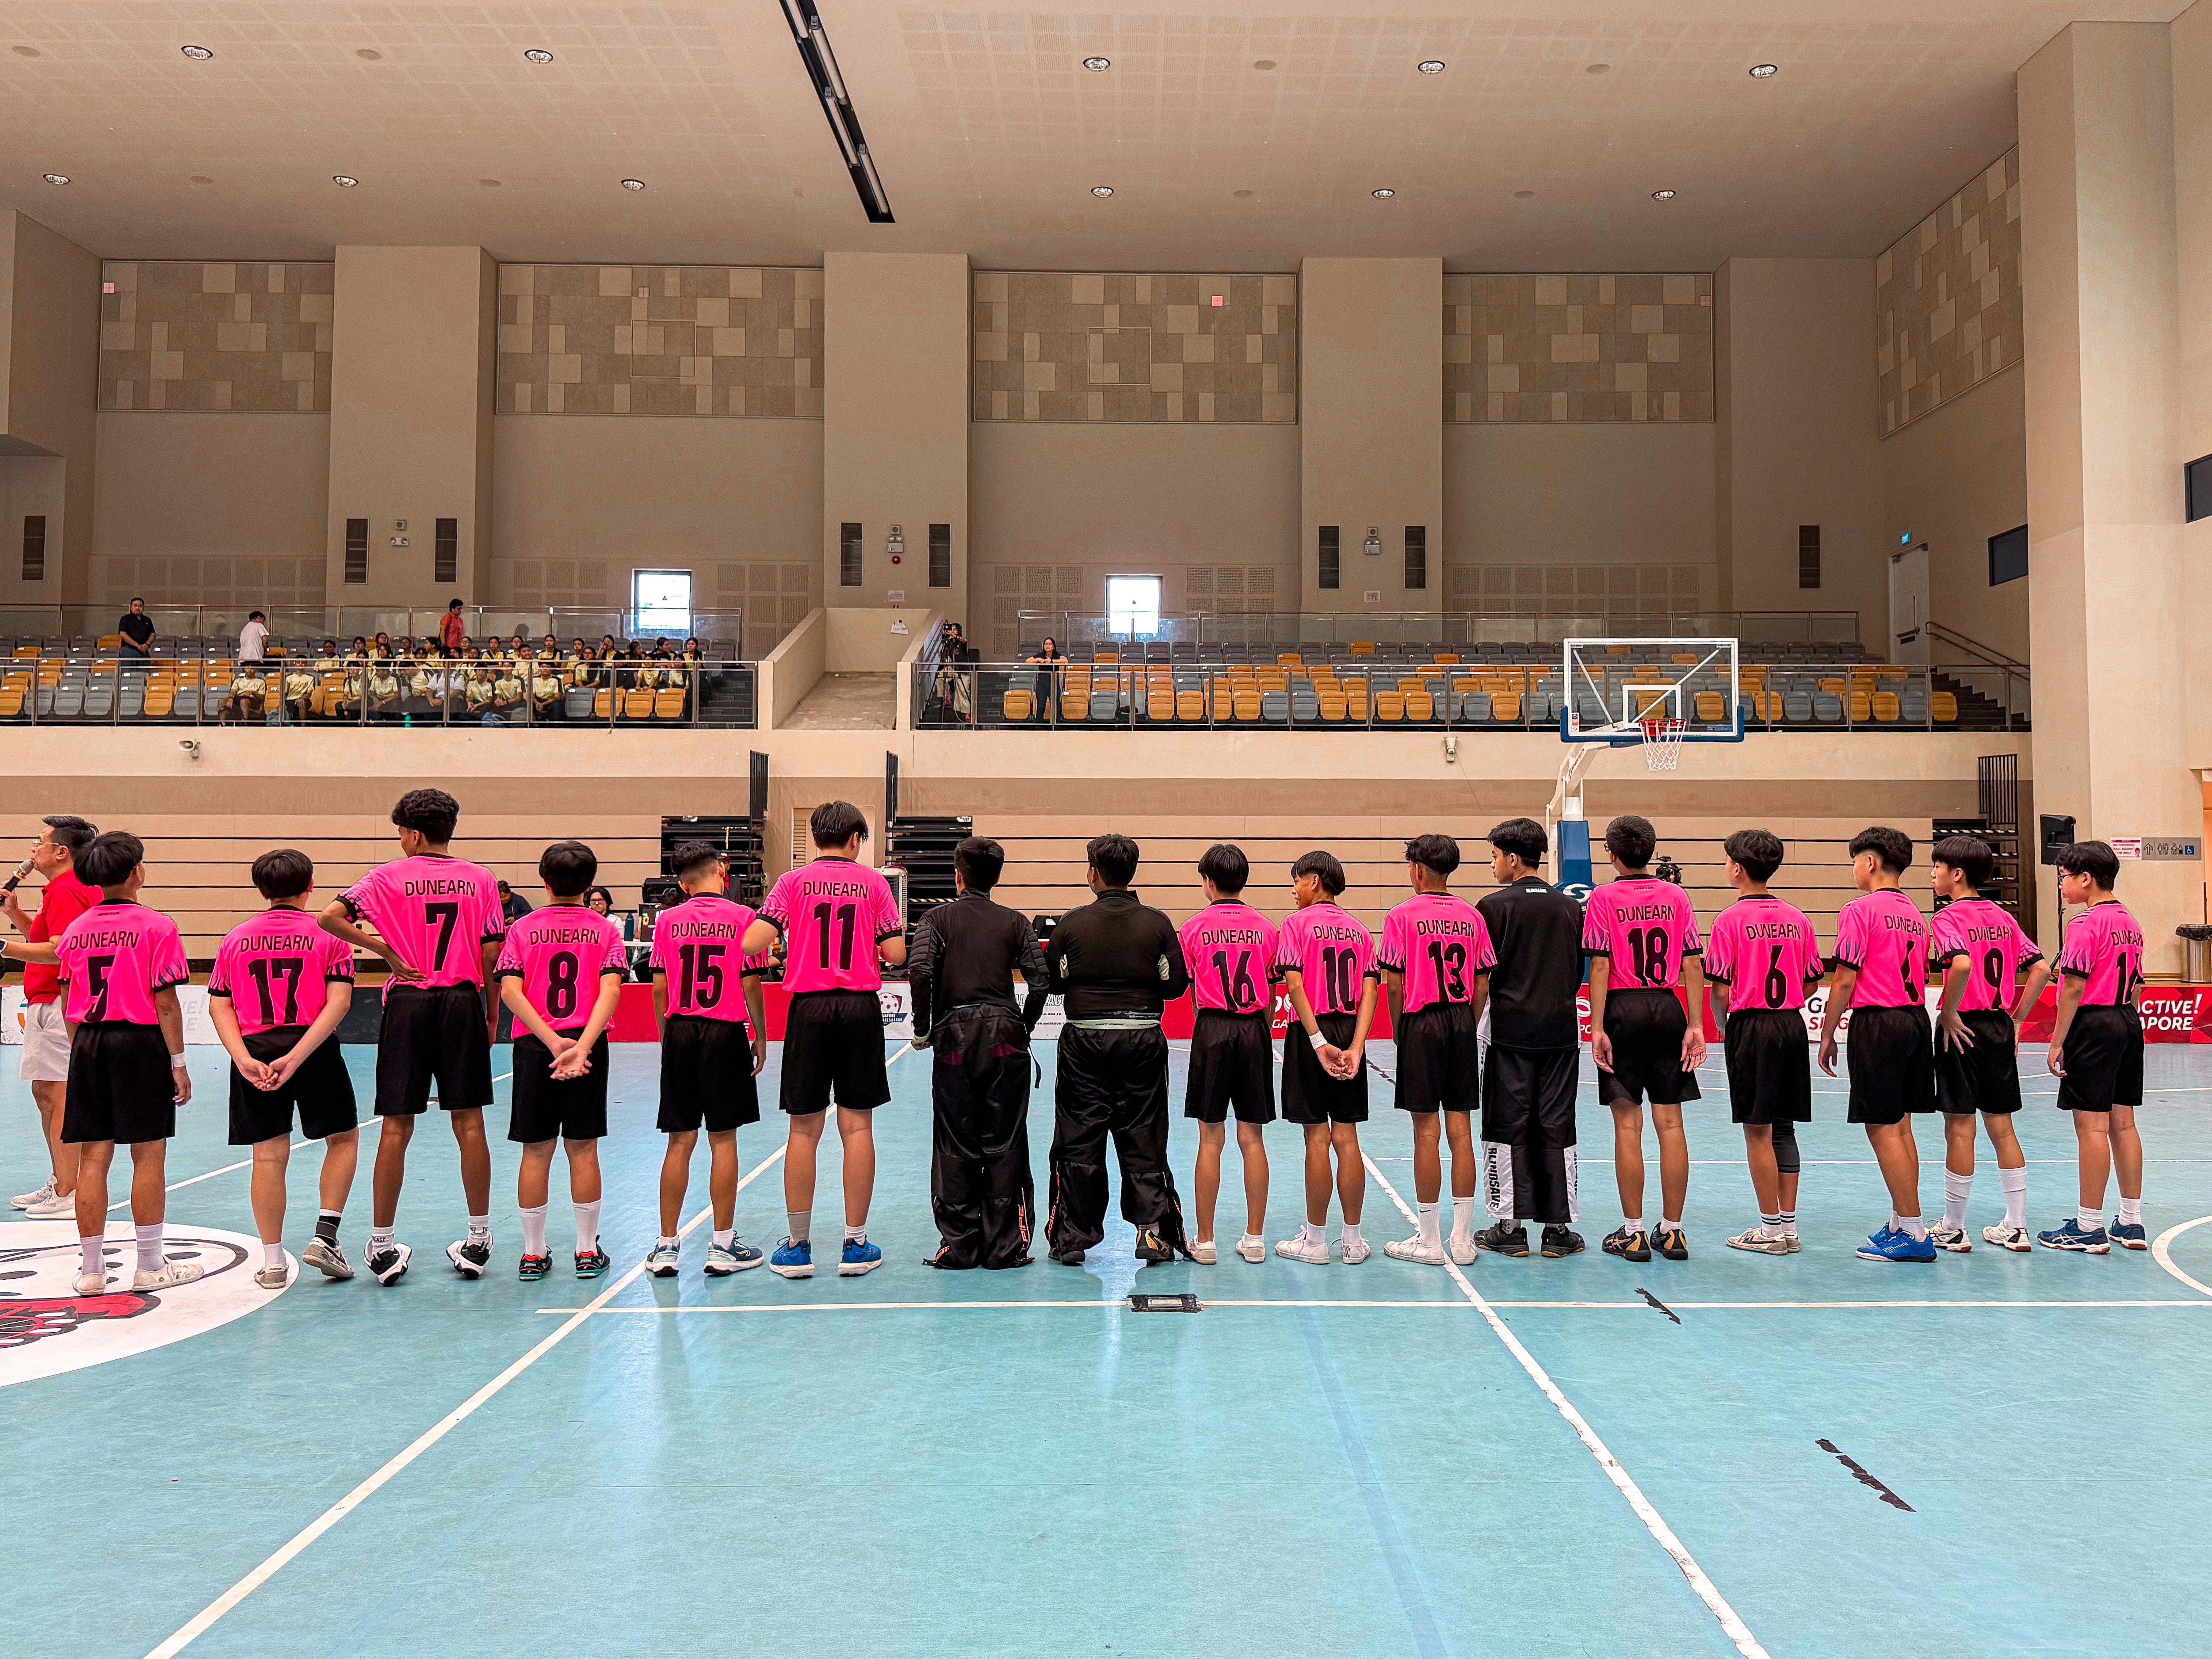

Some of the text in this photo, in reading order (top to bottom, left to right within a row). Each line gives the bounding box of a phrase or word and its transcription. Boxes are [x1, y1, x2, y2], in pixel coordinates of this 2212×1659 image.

[405, 880, 476, 897] DUNEARN
[803, 881, 868, 899] DUNEARN
[1616, 906, 1675, 923] DUNEARN
[69, 932, 139, 950] DUNEARN
[241, 935, 314, 952] DUNEARN
[425, 902, 458, 971] 7
[530, 929, 600, 945] DUNEARN
[672, 923, 737, 939] DUNEARN
[814, 902, 856, 970] 11
[1202, 929, 1263, 945] DUNEARN
[1313, 925, 1364, 945] DUNEARN
[1417, 920, 1474, 938] DUNEARN
[1628, 927, 1669, 987] 18
[1746, 924, 1801, 940] DUNEARN
[85, 955, 115, 1022] 5
[248, 959, 304, 1025] 17
[546, 952, 579, 1018] 8
[679, 944, 726, 1009] 15
[1212, 951, 1256, 1012] 16
[1322, 947, 1357, 1011] 10
[1428, 941, 1466, 1002] 13
[1765, 945, 1786, 1009] 6
[1984, 948, 2003, 1009] 9
